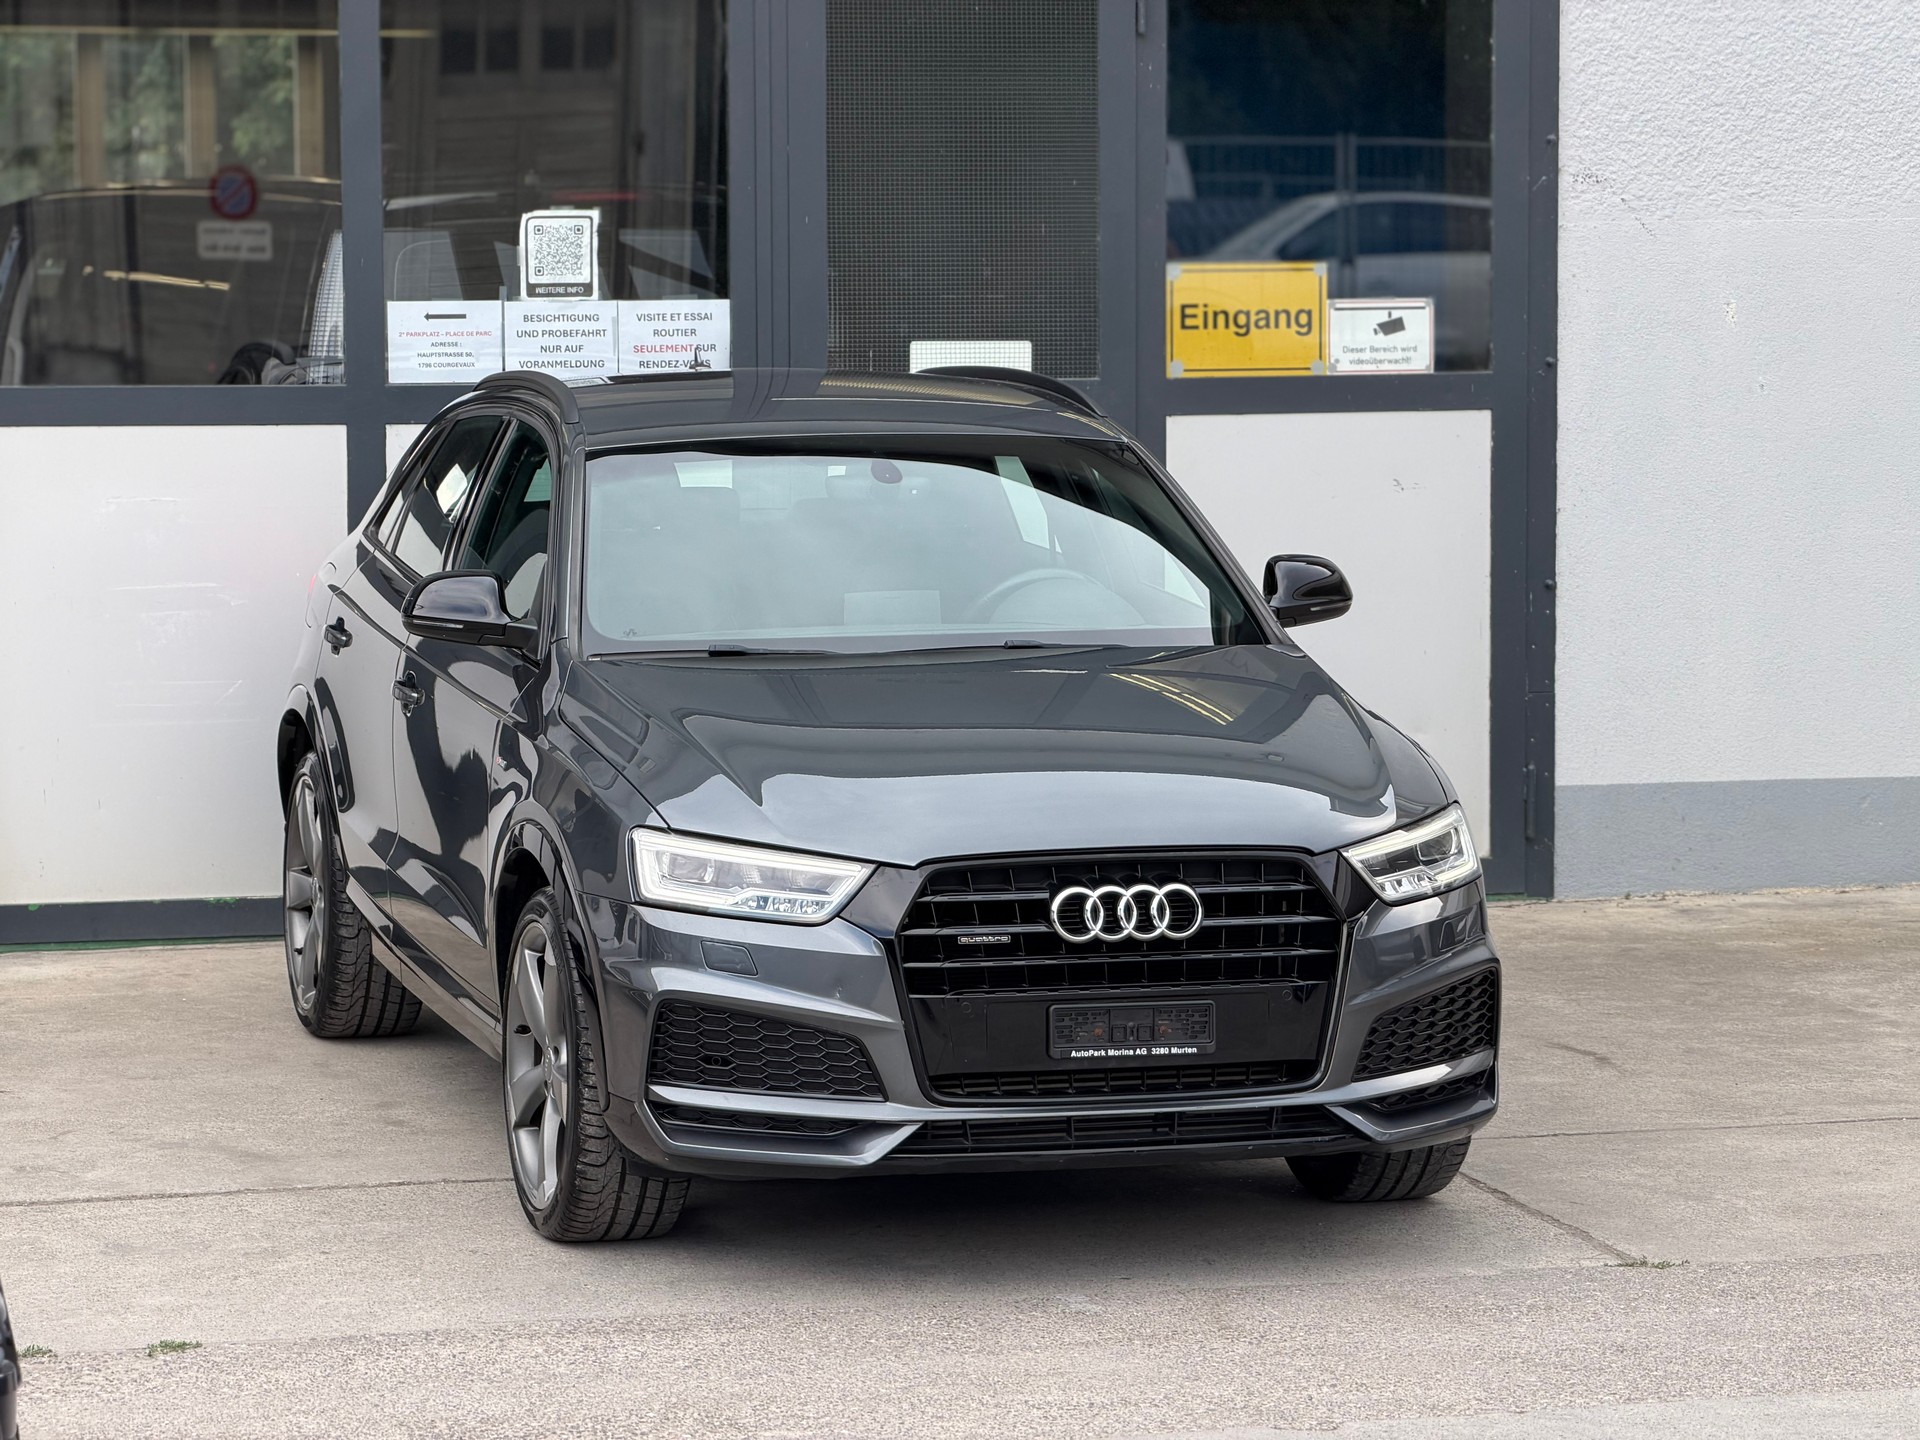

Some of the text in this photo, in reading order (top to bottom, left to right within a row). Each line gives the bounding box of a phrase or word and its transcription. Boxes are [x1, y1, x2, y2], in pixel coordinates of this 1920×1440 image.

[535, 286, 566, 294] WEITERE
[523, 314, 600, 322] BESICHTIGUNG
[636, 312, 713, 322] VISITE ET ESSAI
[1180, 303, 1312, 337] Eingang
[516, 329, 607, 338] UND PROBEFAHRT
[653, 328, 697, 337] ROUTIER
[540, 345, 584, 353] NUR AUF
[633, 343, 717, 353] SEULEMENT SUR
[1342, 344, 1418, 354] Dieser Bereich wird
[518, 360, 605, 369] VORANMELDUNG
[1070, 1049, 1106, 1057] AutoPark
[1107, 1048, 1134, 1056] Morina
[1135, 1047, 1147, 1055] AG
[1170, 1046, 1197, 1054] Murten
